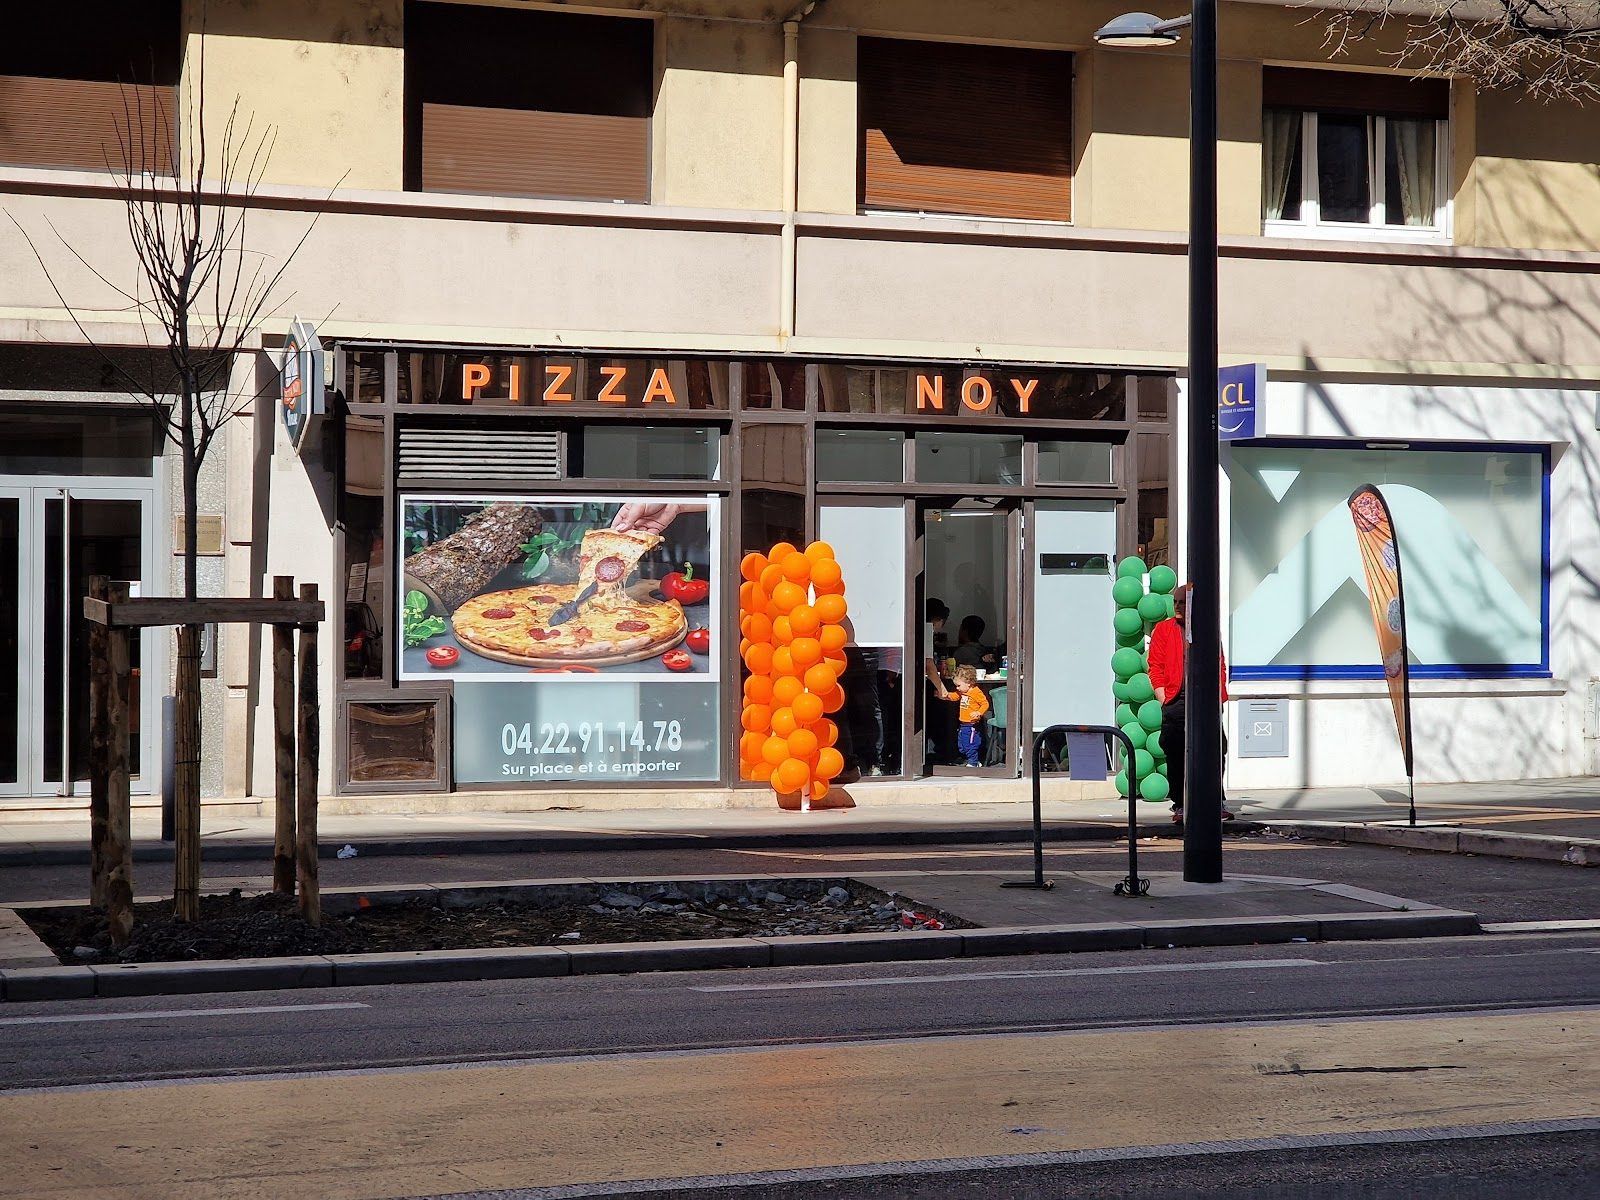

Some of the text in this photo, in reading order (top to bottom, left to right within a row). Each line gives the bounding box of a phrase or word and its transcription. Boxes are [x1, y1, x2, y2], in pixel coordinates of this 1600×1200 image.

[463, 364, 1038, 412] PIZZA NOY
[1218, 383, 1250, 407] CL
[502, 720, 682, 755] 04.22.91.14.78
[502, 760, 681, 777] Sur place et à emporter
